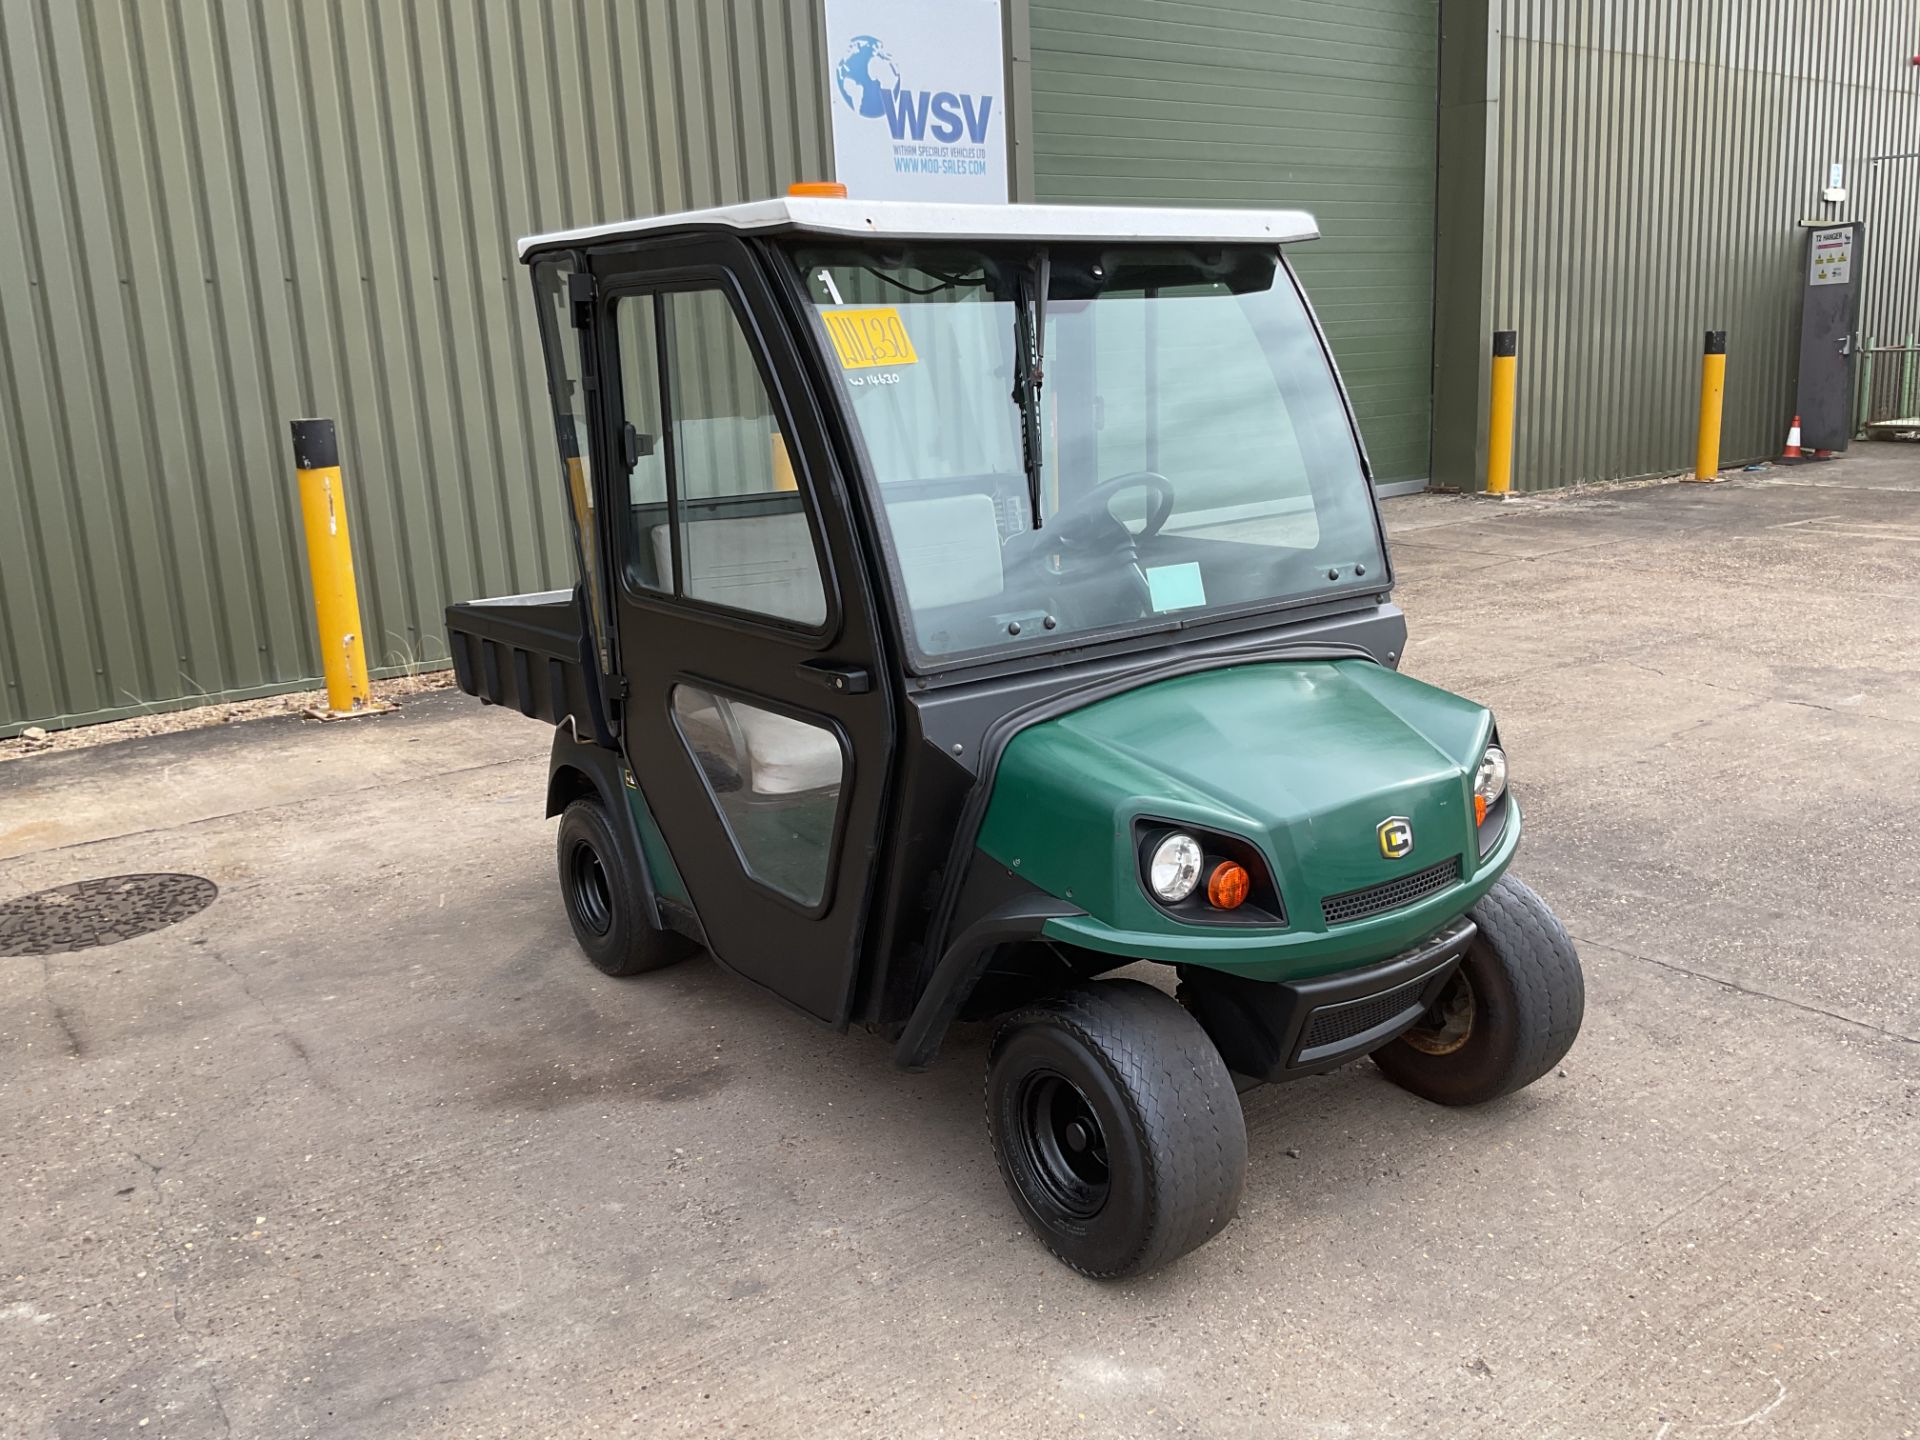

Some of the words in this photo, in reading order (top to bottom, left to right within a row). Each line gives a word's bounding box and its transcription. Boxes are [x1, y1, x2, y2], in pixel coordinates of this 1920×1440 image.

[880, 88, 993, 145] WSV
[893, 145, 917, 156] WITHAM
[918, 146, 949, 158] SPECIALIST
[950, 148, 975, 159] VEHICLES
[976, 149, 986, 159] LTD
